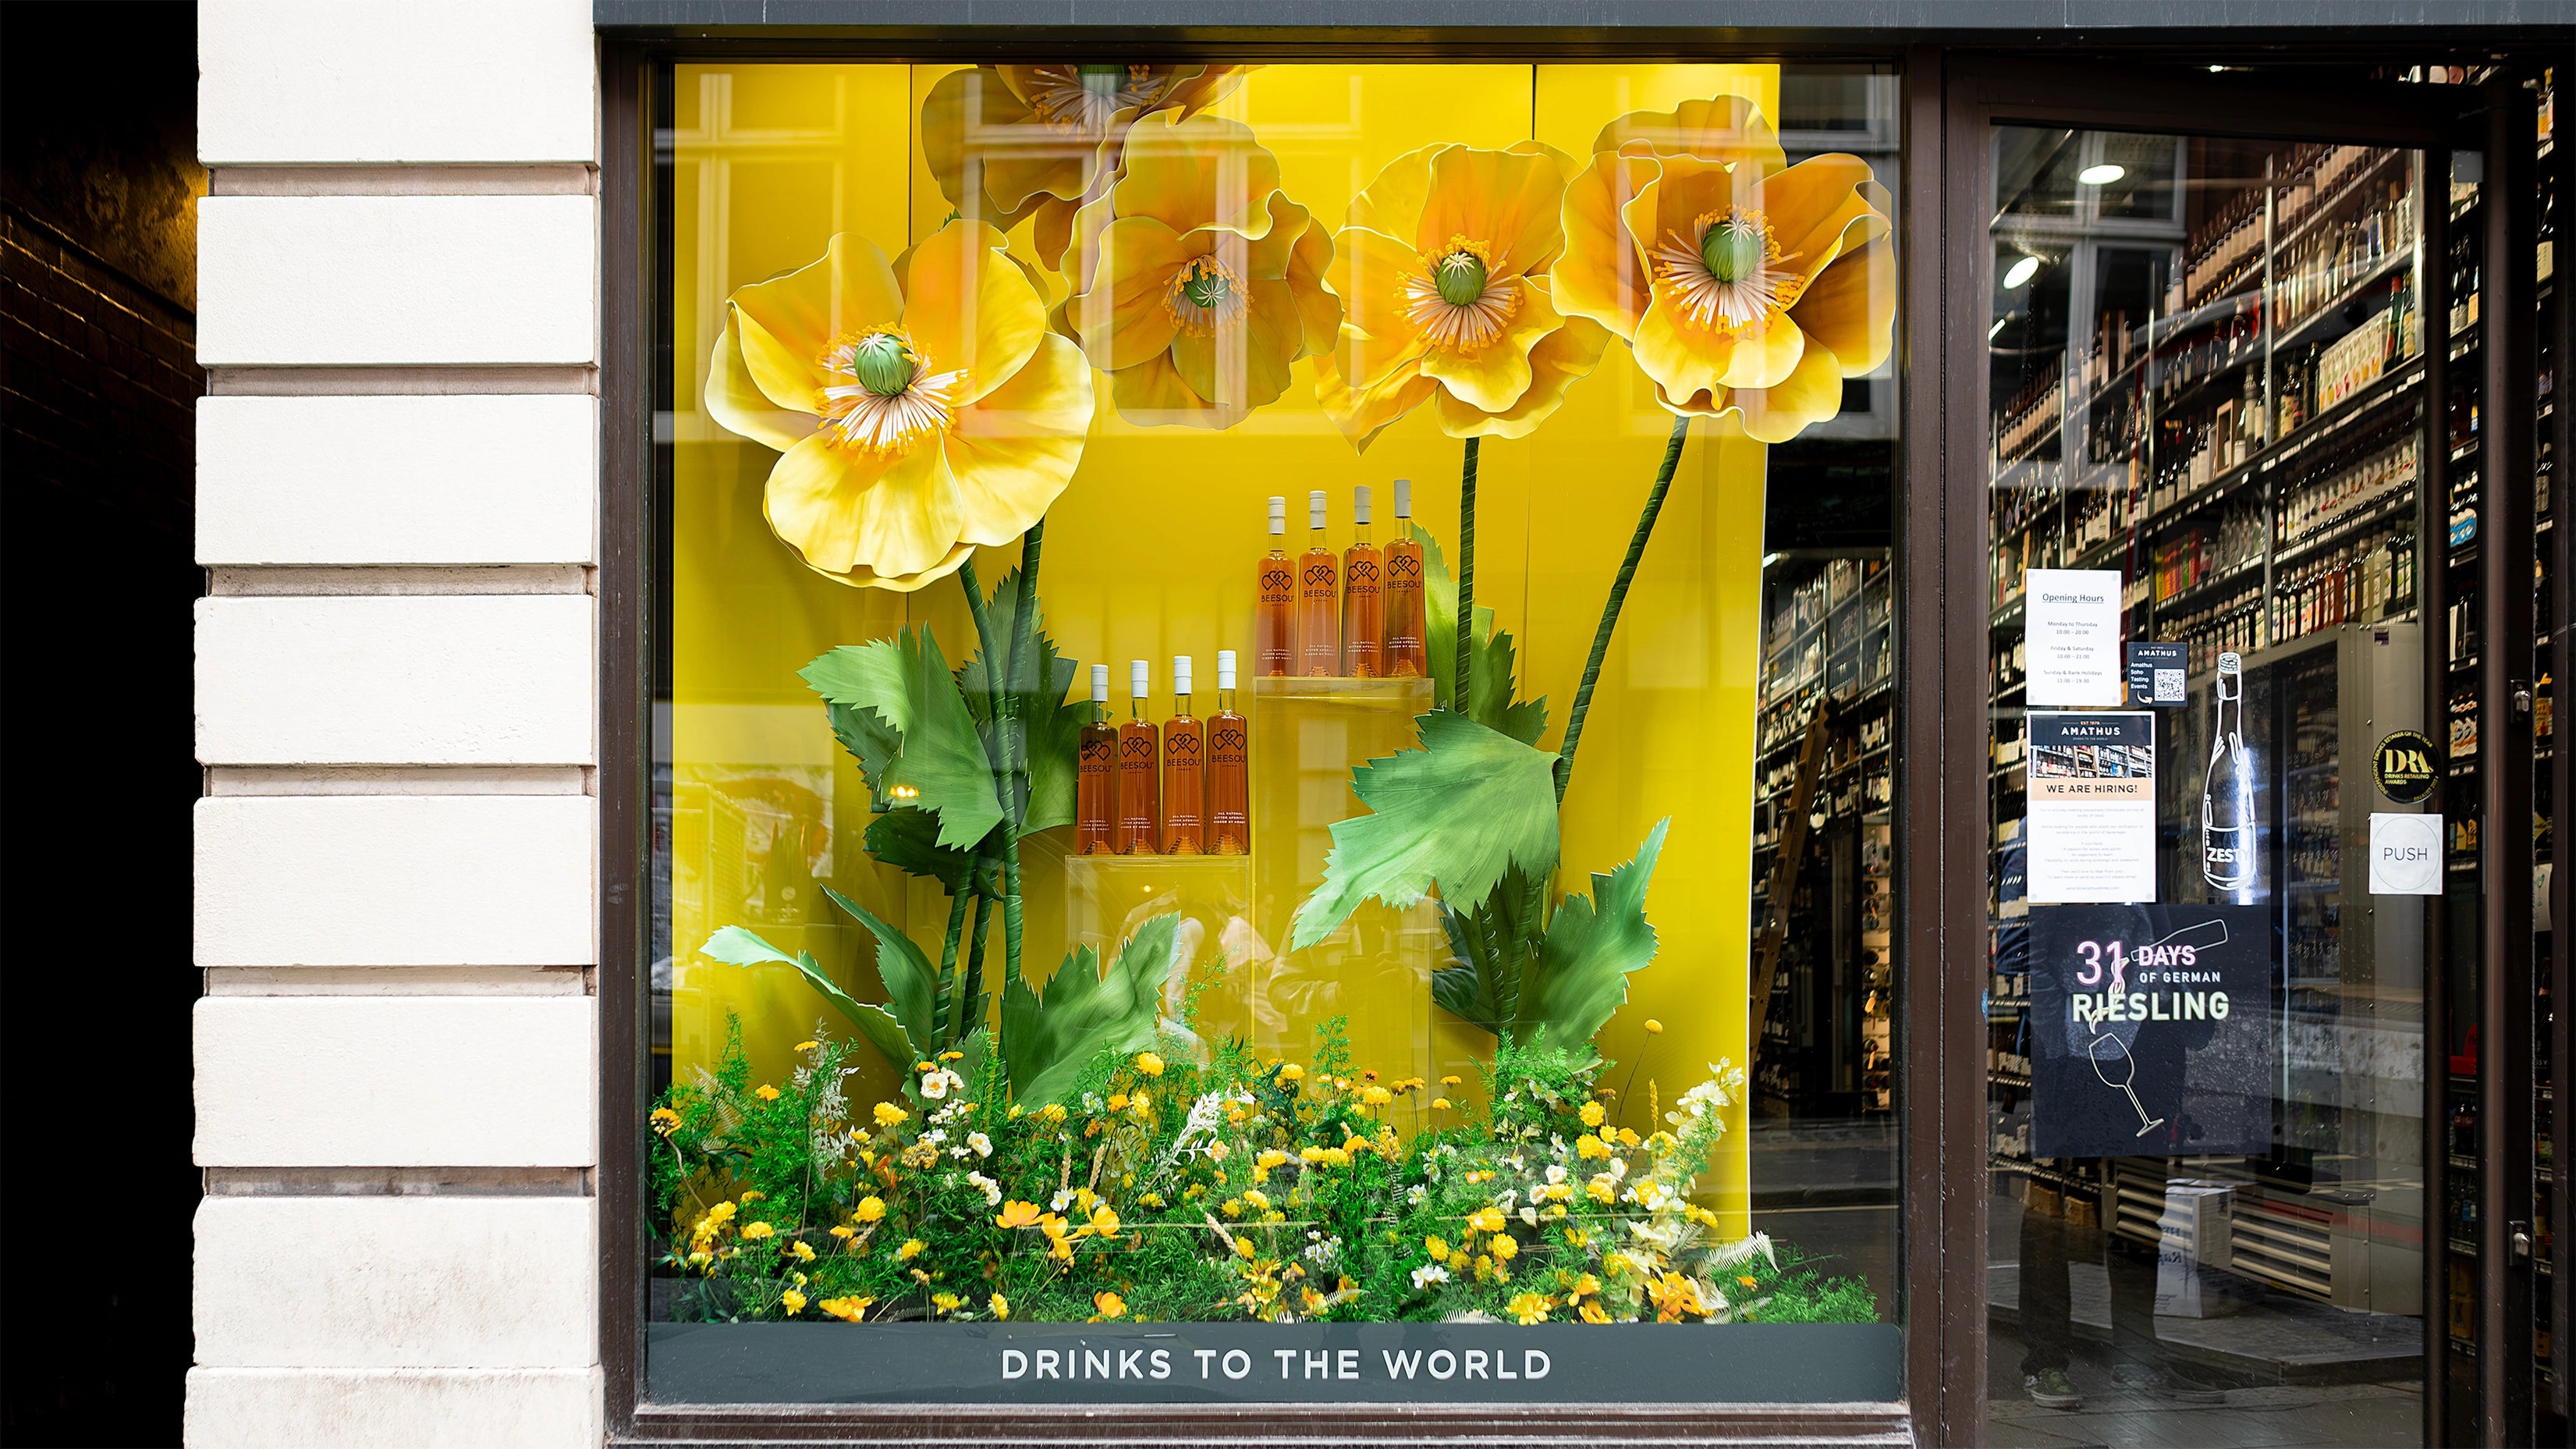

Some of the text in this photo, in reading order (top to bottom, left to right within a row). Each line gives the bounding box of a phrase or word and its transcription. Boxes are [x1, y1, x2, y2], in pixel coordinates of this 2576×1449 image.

[2042, 593, 2104, 603] Opening Hours
[2061, 726, 2120, 736] AMATHUS
[2384, 847, 2428, 861] PUSH
[2077, 940, 2196, 986] 31 DAYS
[2139, 971, 2220, 983] OF GERMAN
[2072, 991, 2230, 1022] RIESLING
[1000, 1348, 1552, 1381] DRINKS TO THE WORLD
